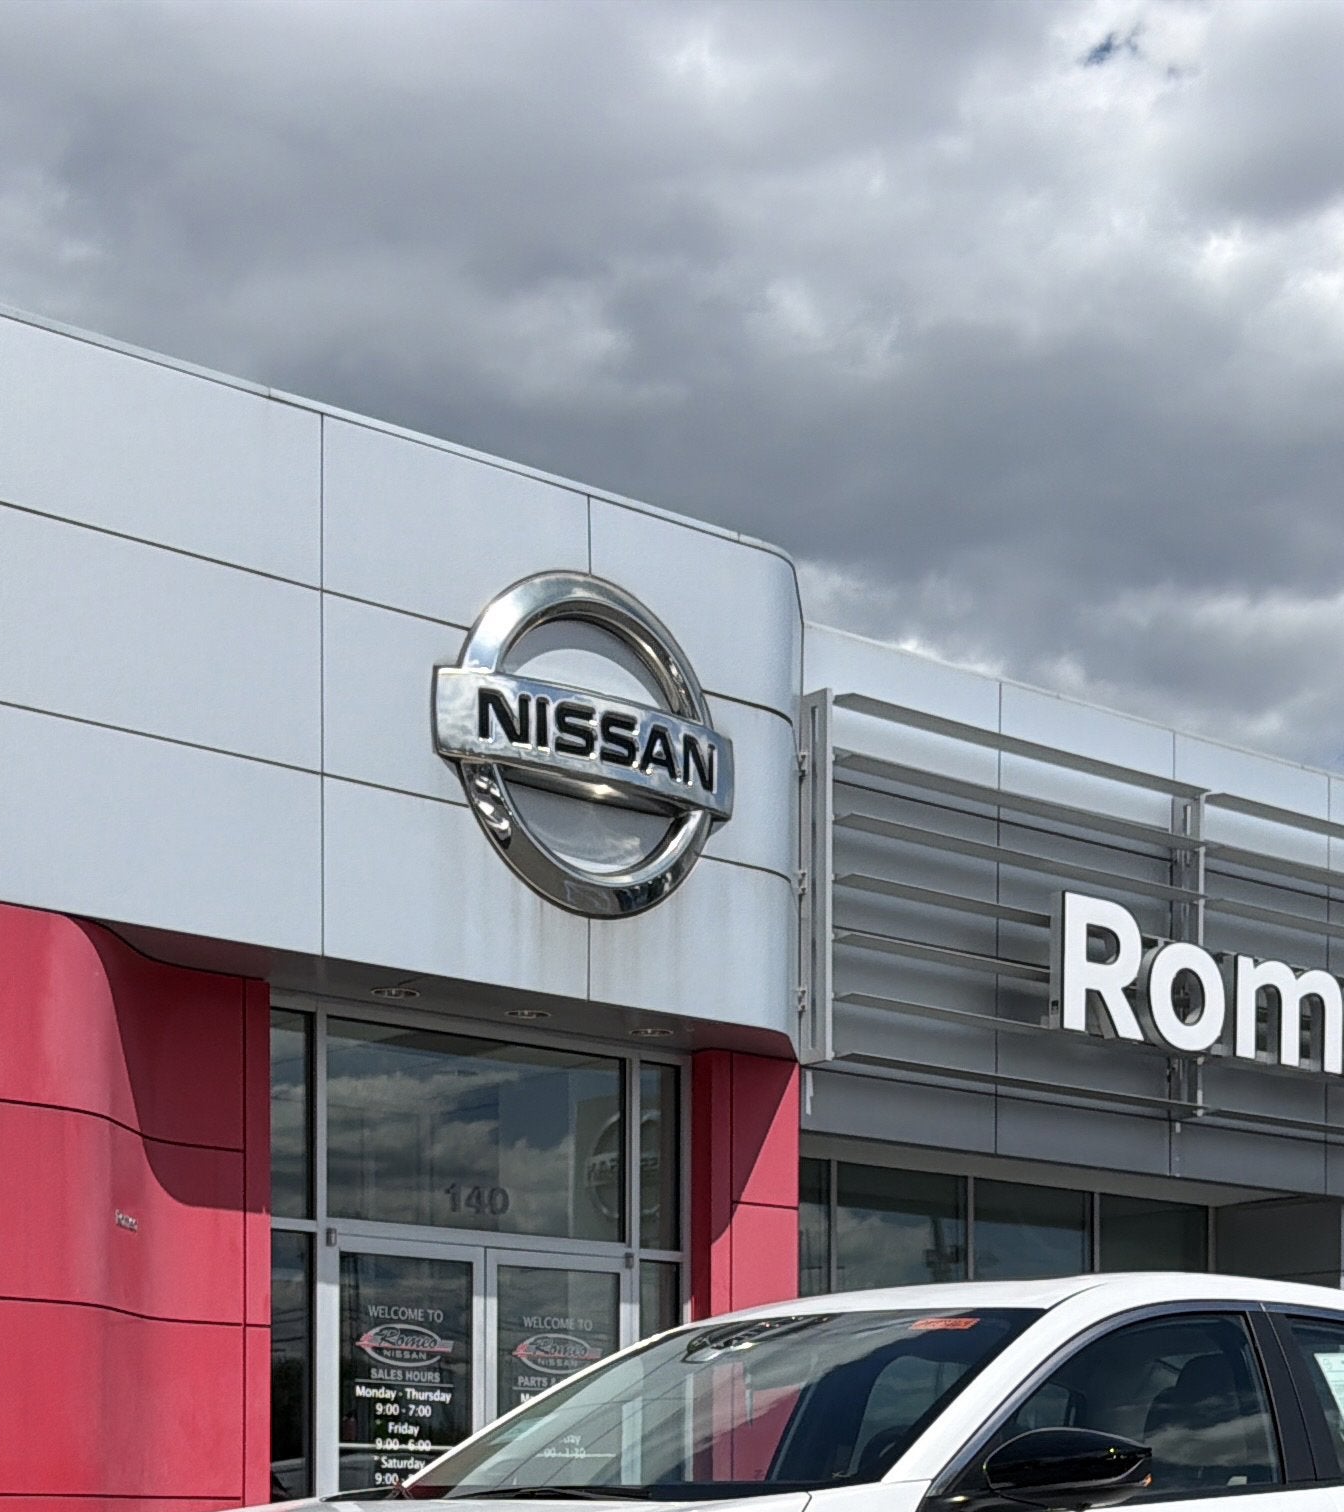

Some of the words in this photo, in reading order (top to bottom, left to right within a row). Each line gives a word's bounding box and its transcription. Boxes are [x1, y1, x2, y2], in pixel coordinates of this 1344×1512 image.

[477, 687, 717, 794] NISSAN
[444, 1183, 510, 1215] 140
[368, 1305, 425, 1321] WELCOME
[428, 1310, 444, 1323] TO
[522, 1316, 575, 1330] WELCOME
[578, 1319, 593, 1331] TO
[374, 1327, 438, 1348] Romeo
[383, 1350, 427, 1360] NISSAN
[537, 1358, 579, 1368] NISSAN
[370, 1368, 403, 1381] SALES
[405, 1371, 440, 1383] HOURS
[518, 1375, 548, 1387] PARTS
[356, 1385, 397, 1401] Monday
[405, 1388, 452, 1404] Thursday
[376, 1403, 399, 1416] 9:00
[408, 1405, 432, 1417] 7:00
[387, 1422, 419, 1436] Friday
[376, 1438, 399, 1450] 9:00
[408, 1440, 432, 1451] 6:00
[380, 1456, 425, 1470] Saturday
[375, 1472, 399, 1486] 9:00
